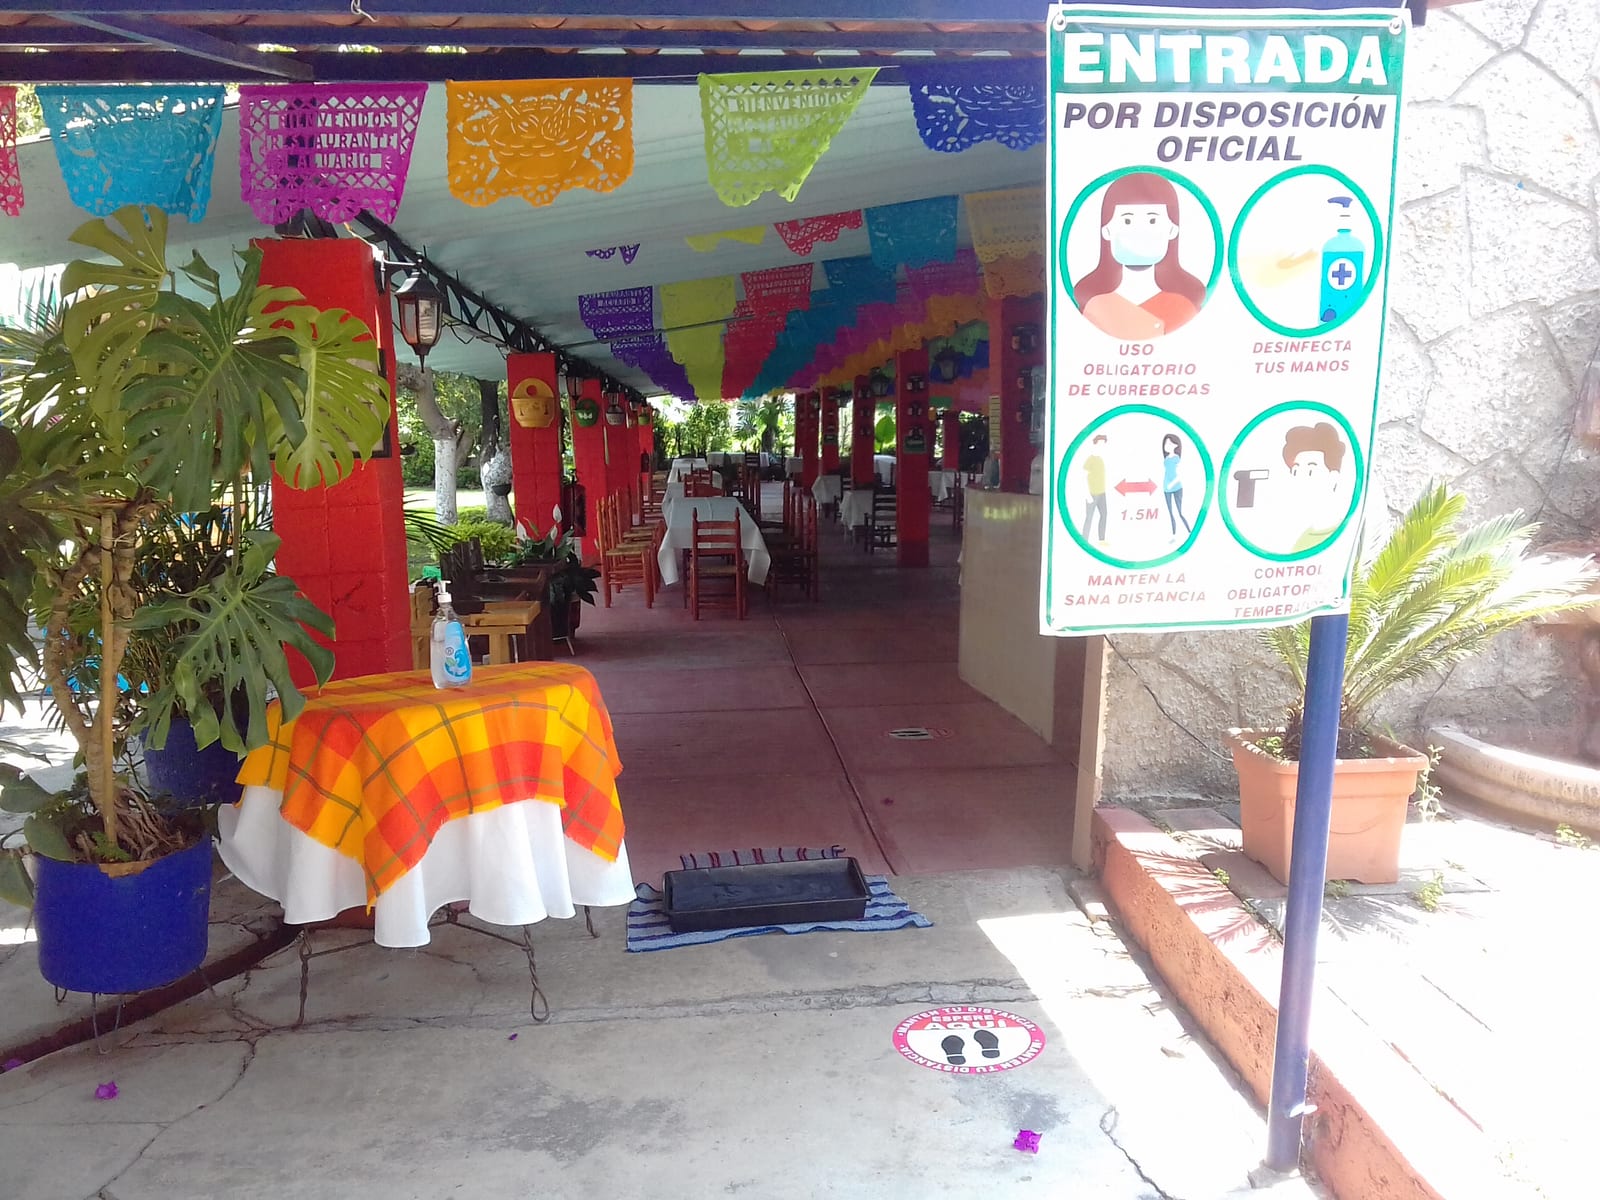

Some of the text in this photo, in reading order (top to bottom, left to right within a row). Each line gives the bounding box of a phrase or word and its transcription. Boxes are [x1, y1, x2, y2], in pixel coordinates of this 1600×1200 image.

[1063, 32, 1388, 86] ENTRADA
[1063, 95, 1387, 129] POR DISPOSICIÓN
[1157, 136, 1303, 162] OFICIAL
[1119, 343, 1154, 356] USO
[1252, 339, 1352, 354] DESINFECTA
[1083, 363, 1197, 376] OBLIGATORIO
[1255, 359, 1350, 374] TUS MANOS
[1068, 383, 1211, 396] DE CUBREBOCAS
[1121, 507, 1159, 521] 1.5M
[1088, 572, 1186, 586] MANTEN LA
[1064, 591, 1207, 606] SANA DISTANCIA
[897, 1010, 940, 1033] MANTEN
[942, 1006, 962, 1014] TU
[932, 1014, 994, 1022] ESPERE
